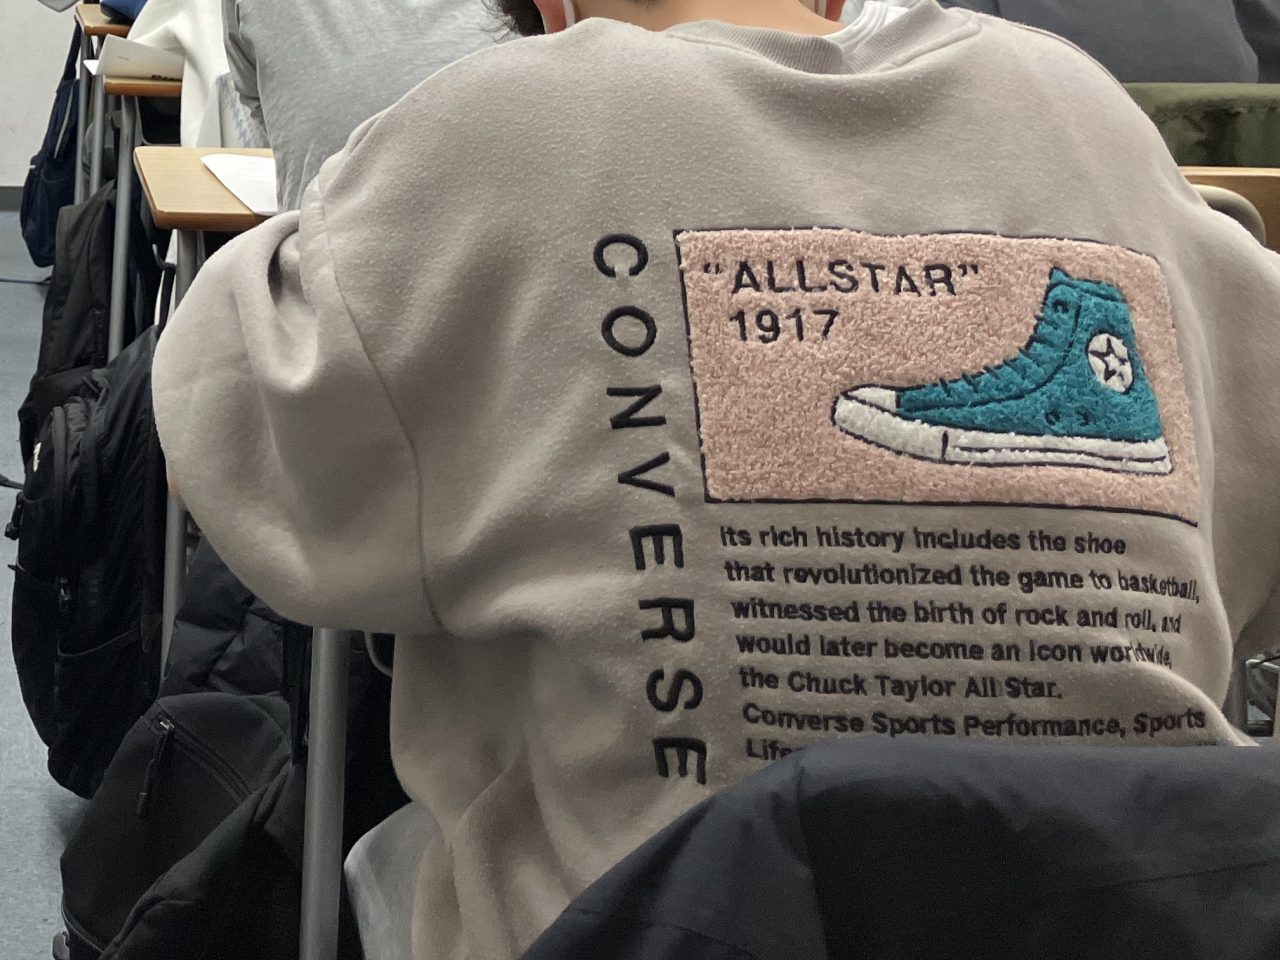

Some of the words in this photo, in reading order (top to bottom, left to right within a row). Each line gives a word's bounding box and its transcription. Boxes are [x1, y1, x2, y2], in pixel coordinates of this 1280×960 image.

[729, 308, 840, 343] 1917
[593, 233, 707, 784] CONVERSE
[721, 527, 751, 547] Its
[760, 527, 807, 547] rich
[817, 527, 905, 554] history
[914, 528, 1019, 550] includes
[1028, 530, 1066, 552] the
[1075, 532, 1126, 555] shoe
[725, 560, 774, 583] that
[784, 562, 962, 586] revolutionized
[970, 565, 1010, 586] the
[1019, 572, 1083, 594] game
[1088, 569, 1111, 590] to
[1118, 571, 1200, 604] basketball,
[732, 598, 859, 622] witnessed
[867, 601, 906, 624] the
[914, 601, 974, 625] birth
[982, 603, 1006, 625] of
[1016, 603, 1069, 627] rock
[1077, 605, 1118, 629] and
[1124, 609, 1156, 633] roll,
[1161, 615, 1181, 635] and
[737, 633, 810, 656] would
[820, 635, 877, 658] later
[884, 637, 984, 661] become
[991, 641, 1021, 662] an
[1029, 638, 1082, 663] icon
[739, 666, 778, 689] the
[787, 670, 867, 695] Chuck
[875, 674, 957, 704] Taylor
[964, 675, 999, 699] All
[742, 703, 864, 733] Converse
[871, 710, 956, 739] Sports
[962, 713, 1126, 738] Performance,
[1133, 709, 1206, 737] Sports
